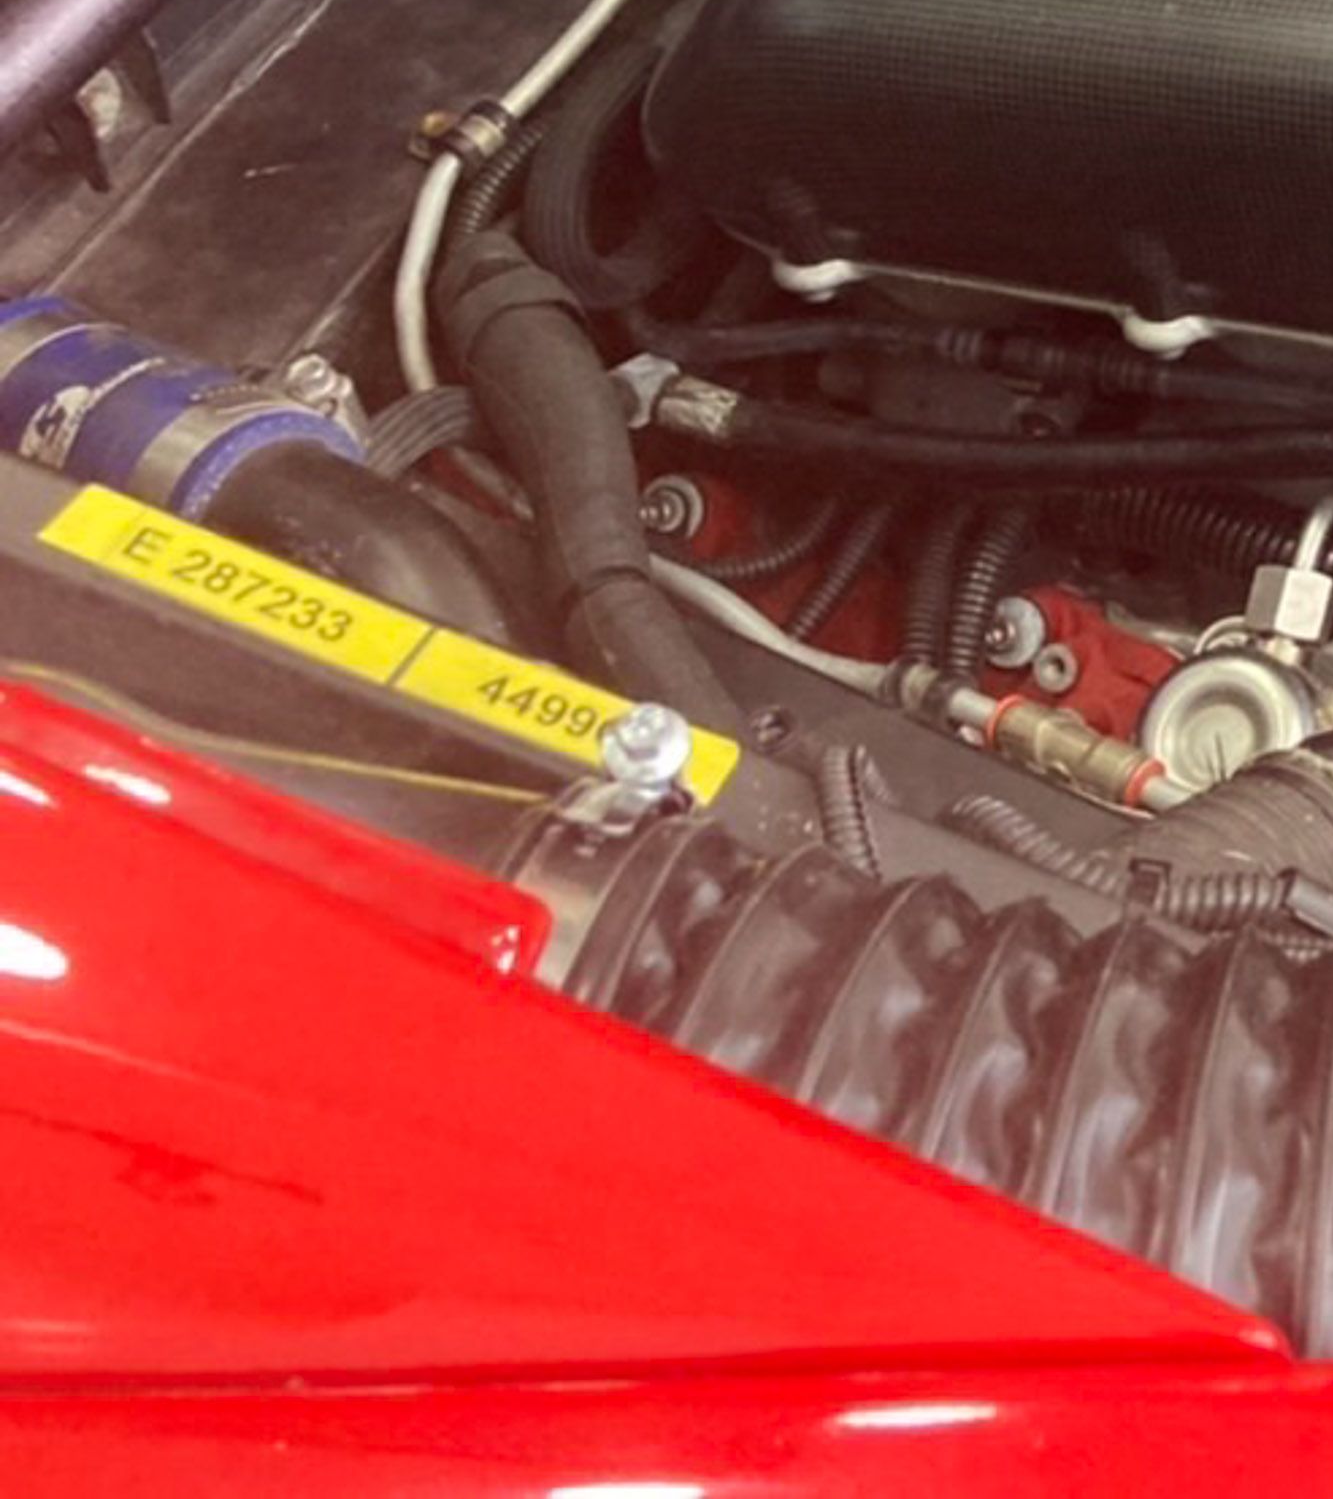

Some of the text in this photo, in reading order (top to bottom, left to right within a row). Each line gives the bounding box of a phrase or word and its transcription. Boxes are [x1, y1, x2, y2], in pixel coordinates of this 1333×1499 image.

[122, 526, 354, 643] E 287233
[475, 674, 612, 742] 4499
